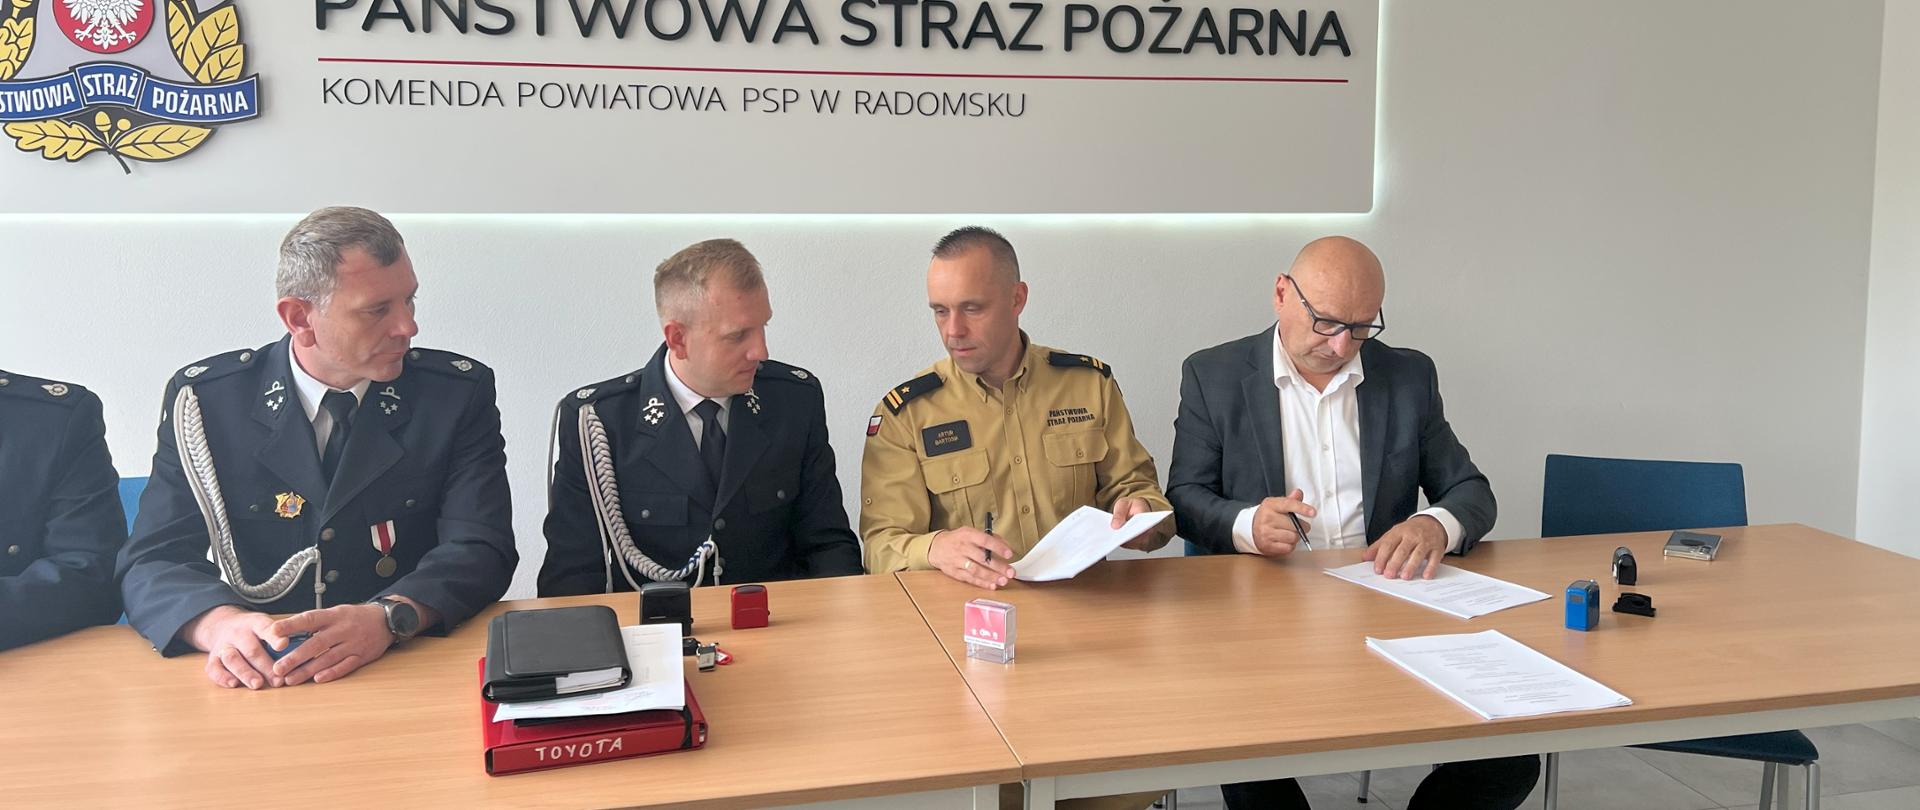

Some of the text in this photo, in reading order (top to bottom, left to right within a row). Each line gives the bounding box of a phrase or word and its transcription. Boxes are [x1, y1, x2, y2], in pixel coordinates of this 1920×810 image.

[1064, 0, 1352, 57] POŻARNA
[82, 72, 138, 99] STRAŻ
[152, 86, 249, 116] POŻARNA
[322, 77, 1027, 118] KOMENDA POWIATOWA PSP W RADOMSKU
[535, 737, 623, 761] TOYOTA
